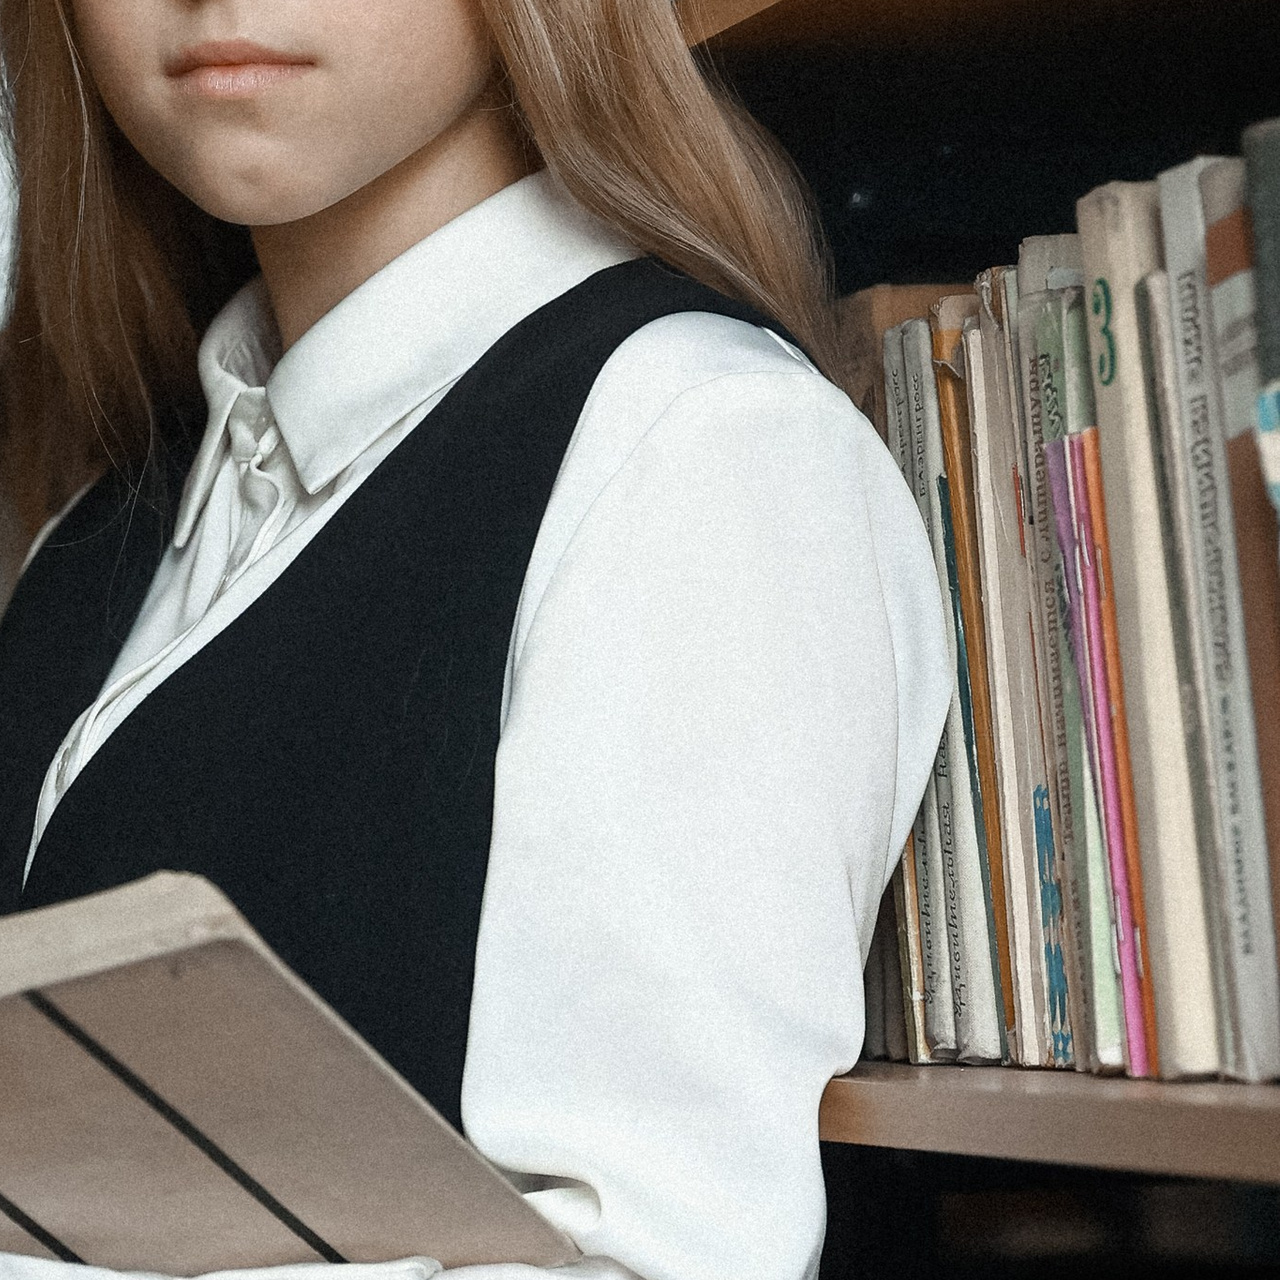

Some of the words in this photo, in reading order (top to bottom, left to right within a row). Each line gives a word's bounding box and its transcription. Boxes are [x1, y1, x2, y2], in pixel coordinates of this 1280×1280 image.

[1092, 276, 1117, 387] 3
[1027, 354, 1052, 543] литературы
[1042, 578, 1068, 748] начинается
